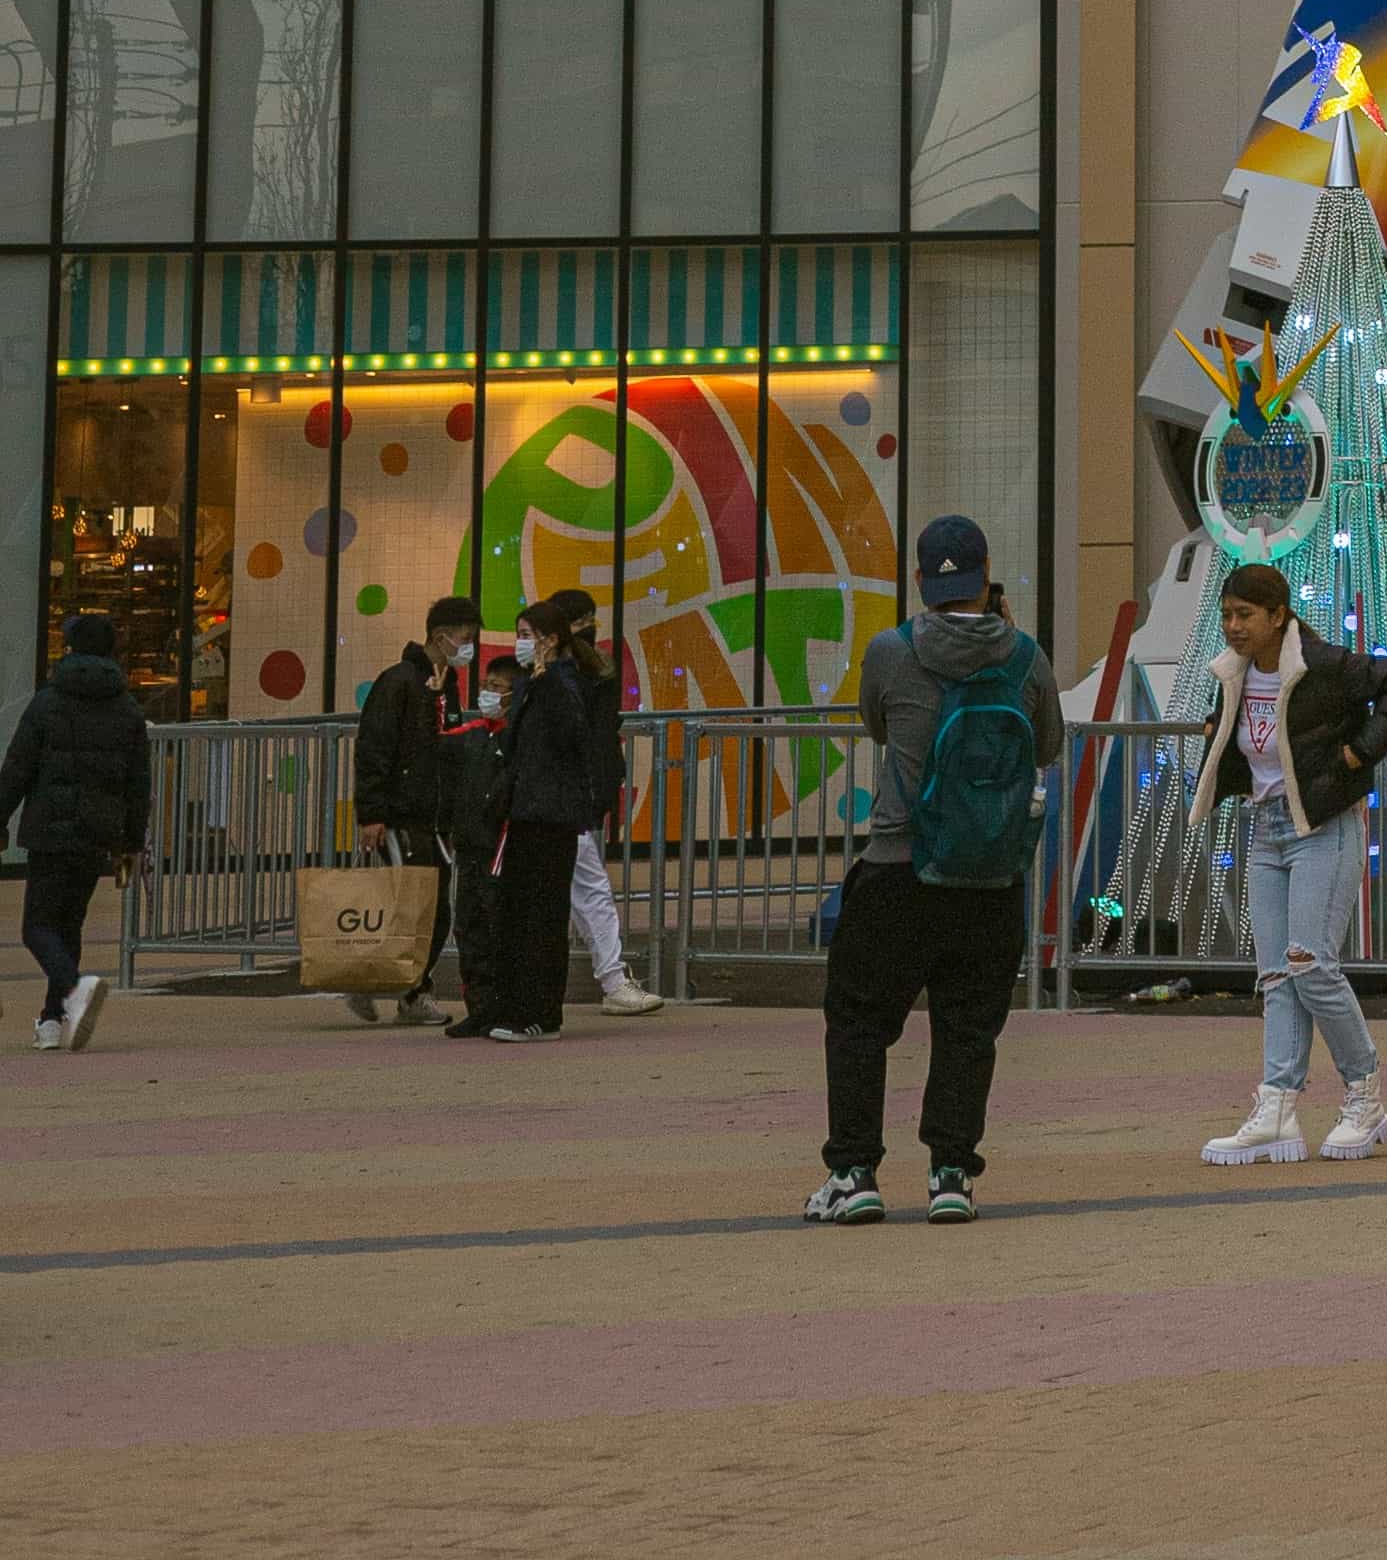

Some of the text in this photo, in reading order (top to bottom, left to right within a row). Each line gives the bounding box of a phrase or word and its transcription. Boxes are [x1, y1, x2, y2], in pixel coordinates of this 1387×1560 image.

[1223, 443, 1307, 473] WINTER
[1249, 701, 1276, 715] GUES
[337, 908, 383, 933] GU
